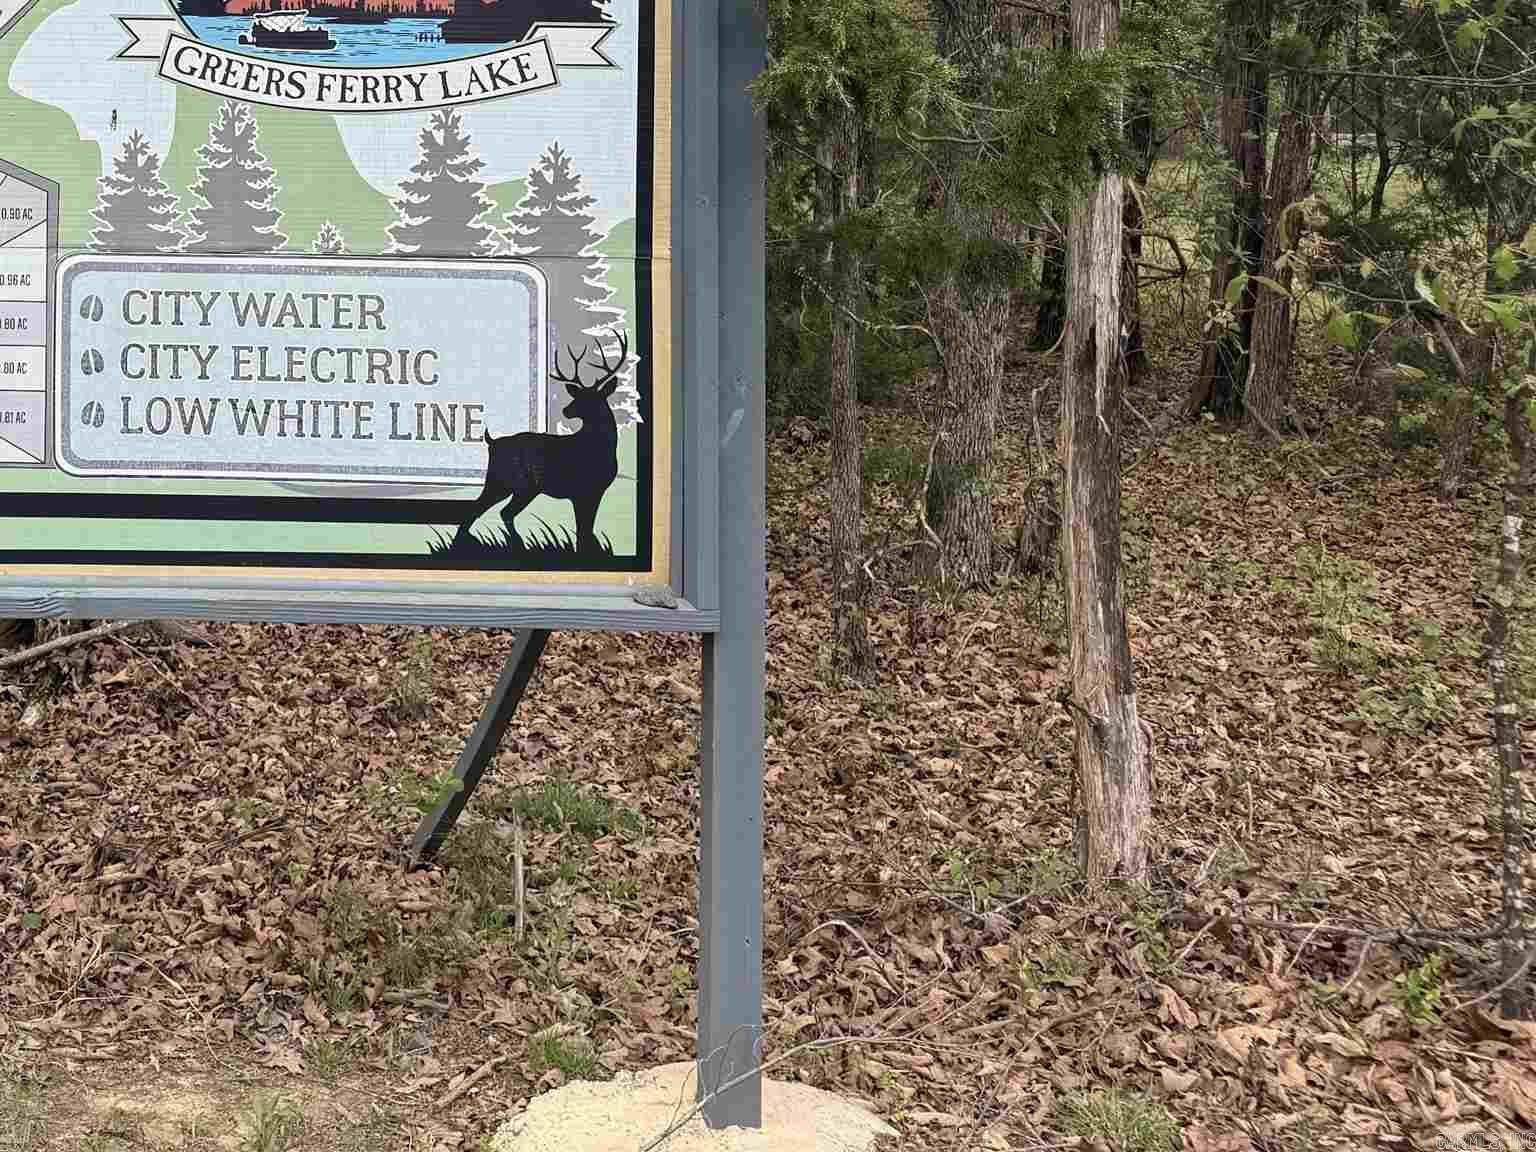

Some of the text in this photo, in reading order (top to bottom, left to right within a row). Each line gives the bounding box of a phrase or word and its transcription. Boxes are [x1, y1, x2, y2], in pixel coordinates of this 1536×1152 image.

[174, 47, 538, 104] GREERS FERRY LAKE
[23, 208, 33, 220] AC
[20, 274, 31, 286] AC
[122, 289, 387, 330] CITY WATER
[17, 318, 28, 330] AC
[17, 362, 28, 374] AC
[120, 343, 440, 385] CITY ELECTRIC
[15, 411, 26, 424] AC
[120, 396, 485, 442] LOW WHITE LINE
